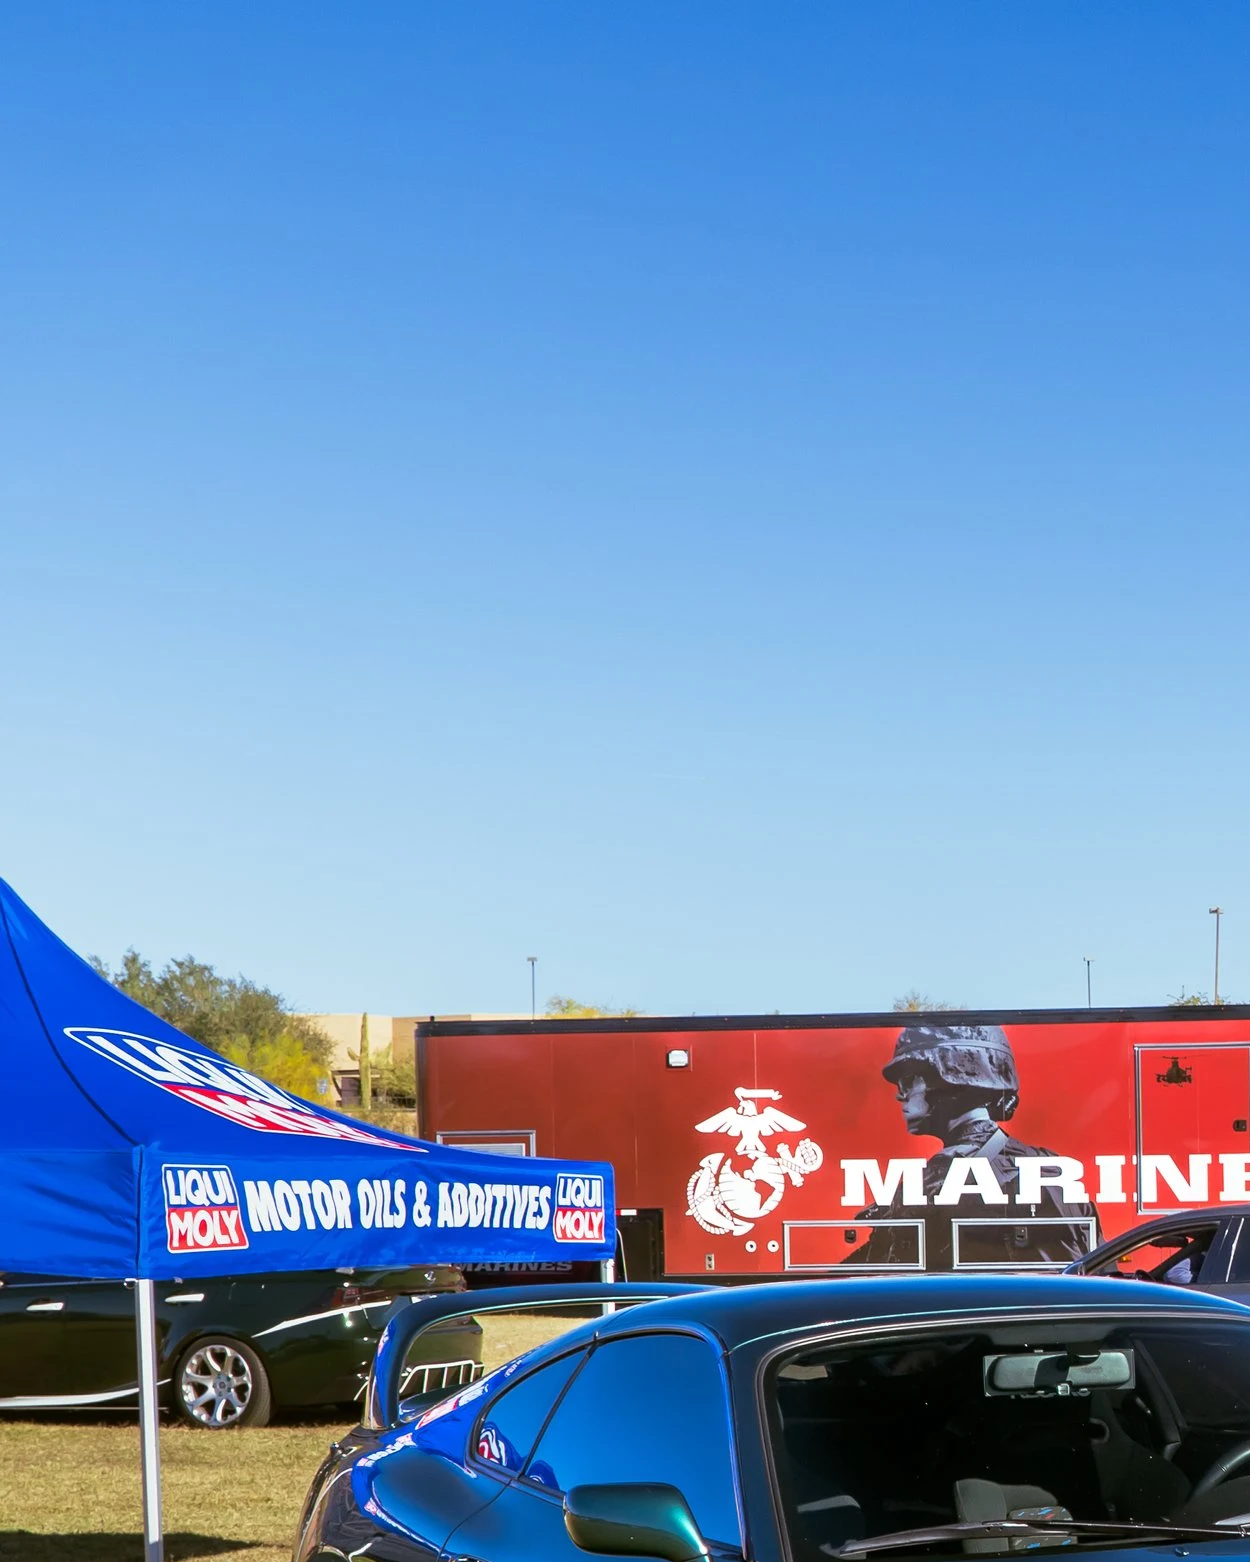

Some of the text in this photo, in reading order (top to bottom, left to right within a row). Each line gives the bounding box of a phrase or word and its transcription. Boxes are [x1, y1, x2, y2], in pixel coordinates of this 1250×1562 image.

[166, 1169, 235, 1207] LIQUI
[243, 1179, 552, 1233] MOTOR OILS & ADDITIVES
[558, 1178, 601, 1208] LIQUI
[169, 1209, 239, 1248] MOLY
[555, 1210, 604, 1239] MOLY
